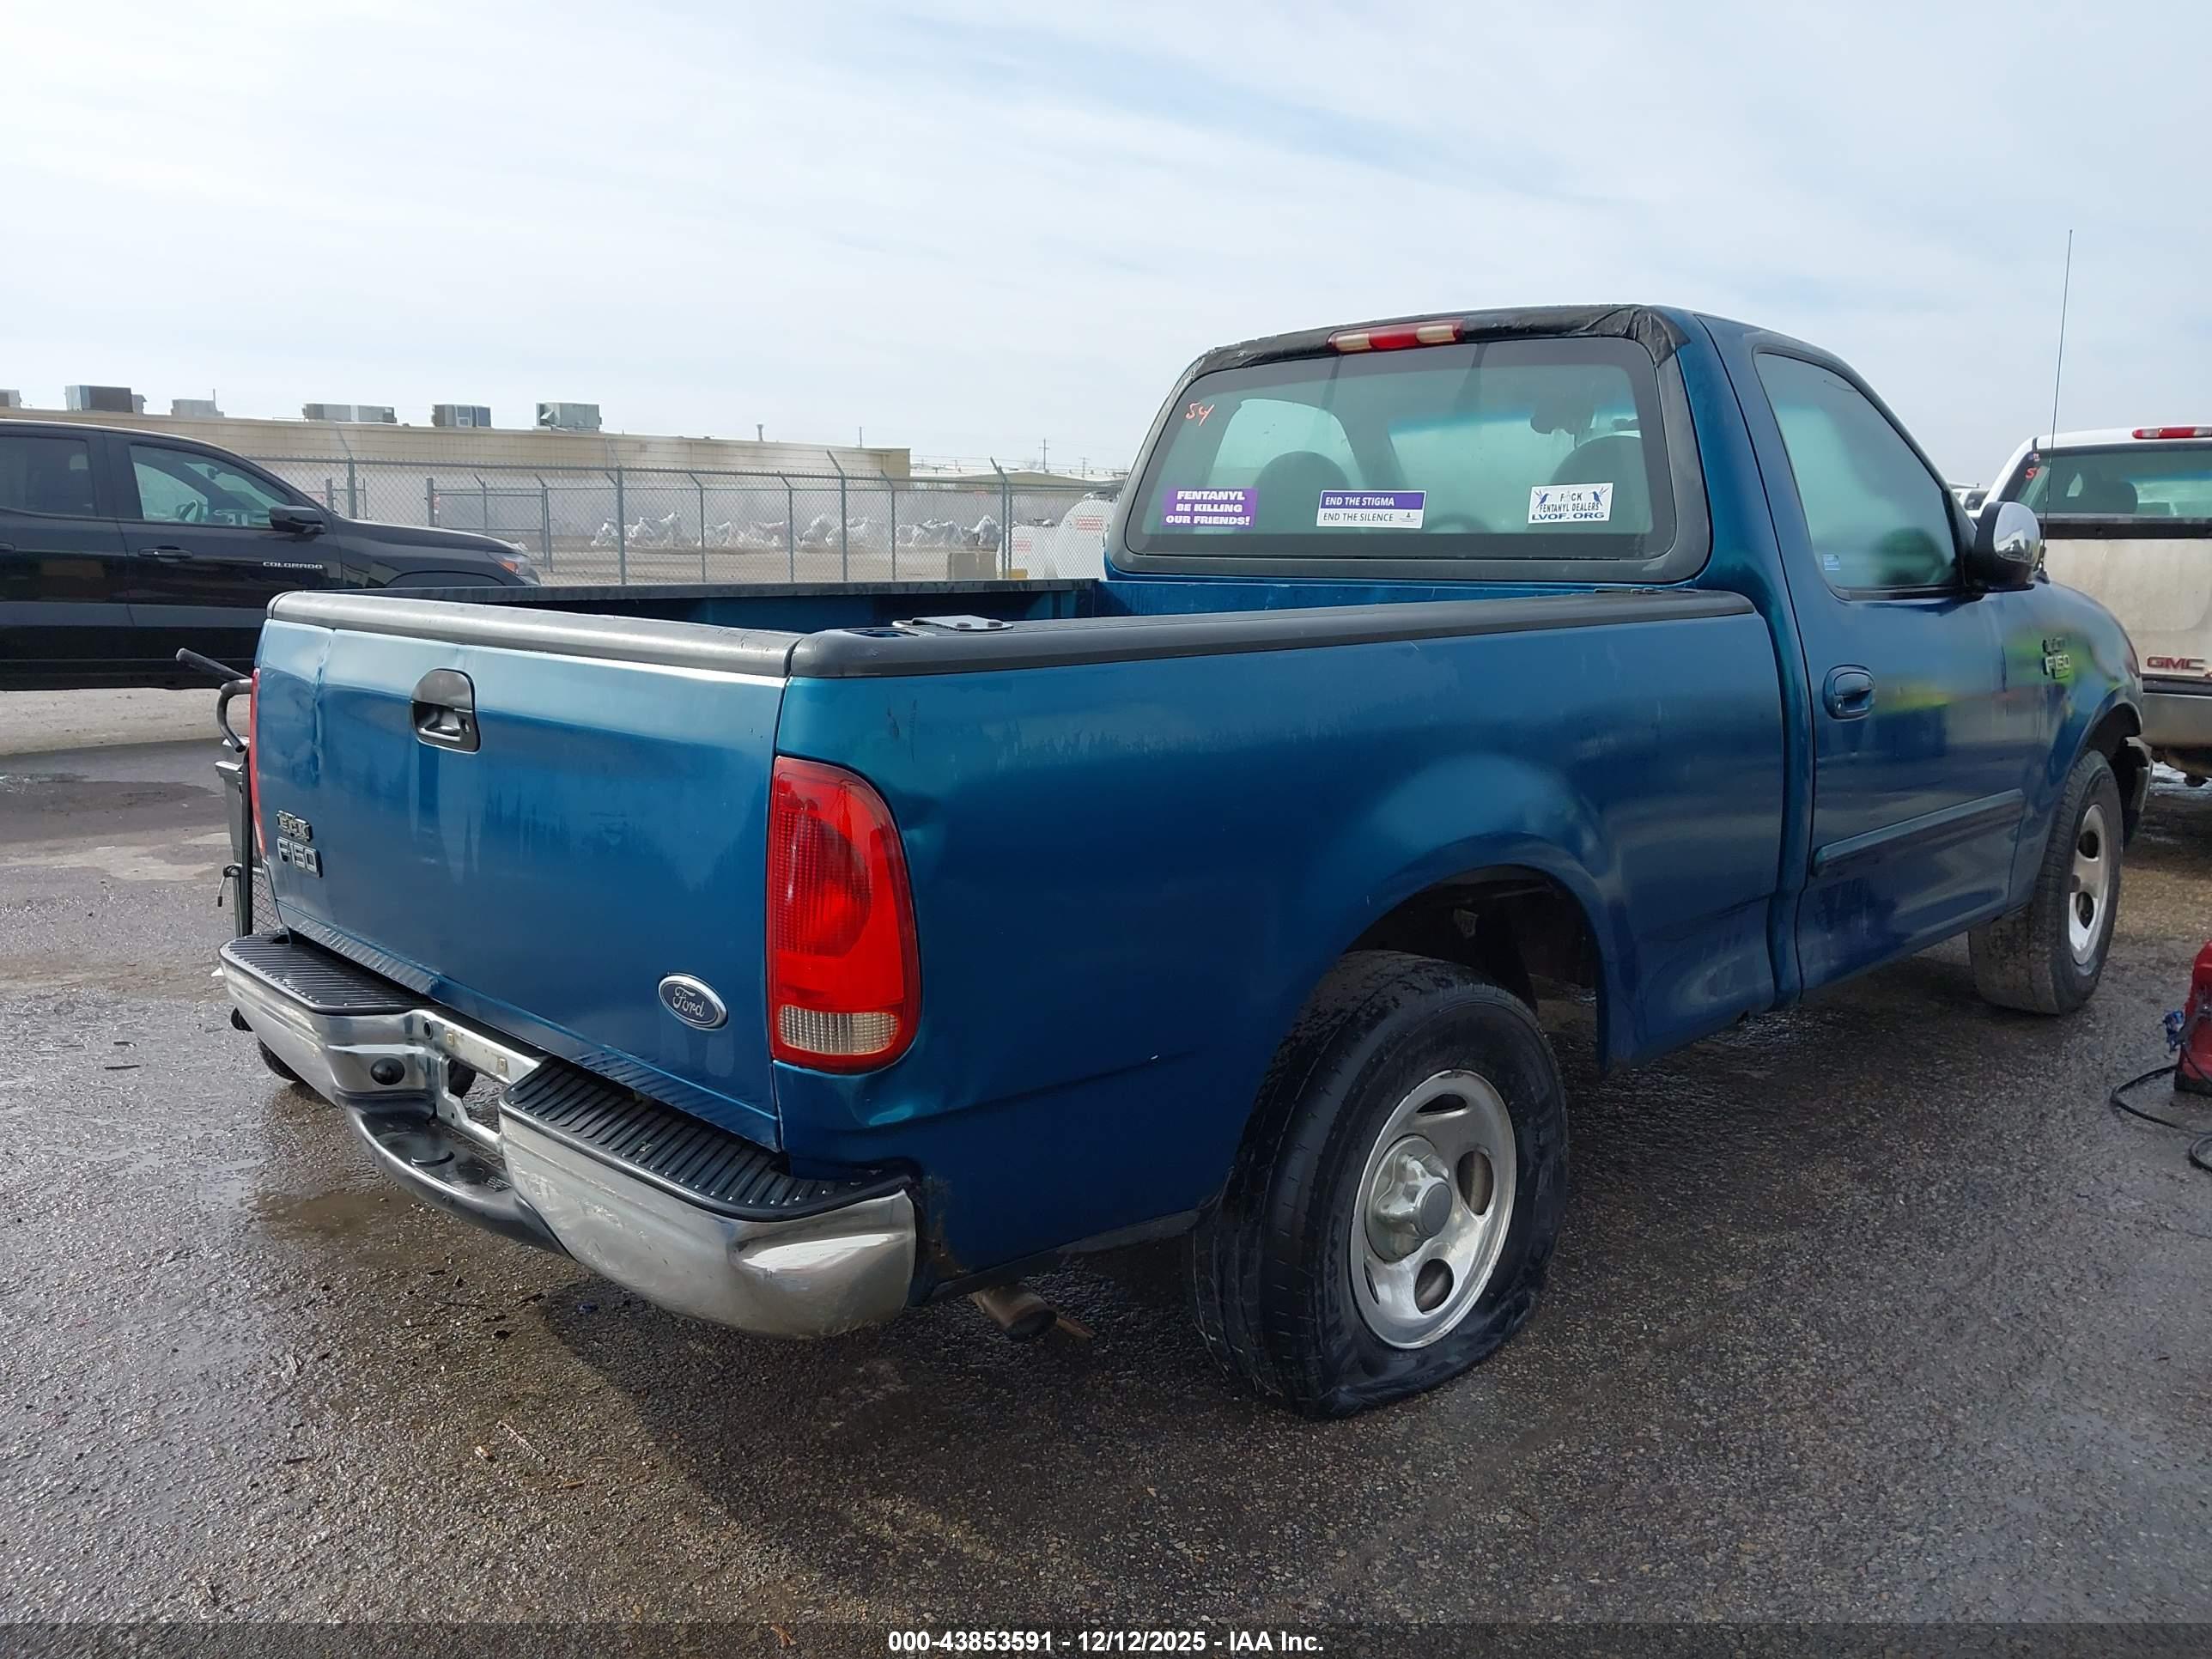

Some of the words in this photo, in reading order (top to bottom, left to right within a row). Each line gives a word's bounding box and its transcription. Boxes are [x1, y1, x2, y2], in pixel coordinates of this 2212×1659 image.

[1176, 490, 1245, 501] FENTANYL
[1560, 493, 1583, 501] FCK
[1325, 497, 1343, 506] END
[1345, 497, 1360, 506] THE
[1362, 497, 1395, 507] STIGMA
[1540, 503, 1570, 513] FENTANYL
[1571, 501, 1600, 511] DEALERS
[1176, 503, 1192, 512] BE
[1194, 503, 1243, 513] KILLING
[1165, 515, 1191, 524] OUR
[1194, 516, 1250, 526] FRIENDS!
[1323, 513, 1340, 521] END
[1342, 513, 1358, 521] THE
[1359, 514, 1394, 522] SILENCE
[2147, 656, 2205, 671] GMC
[672, 986, 705, 1018] Ford
